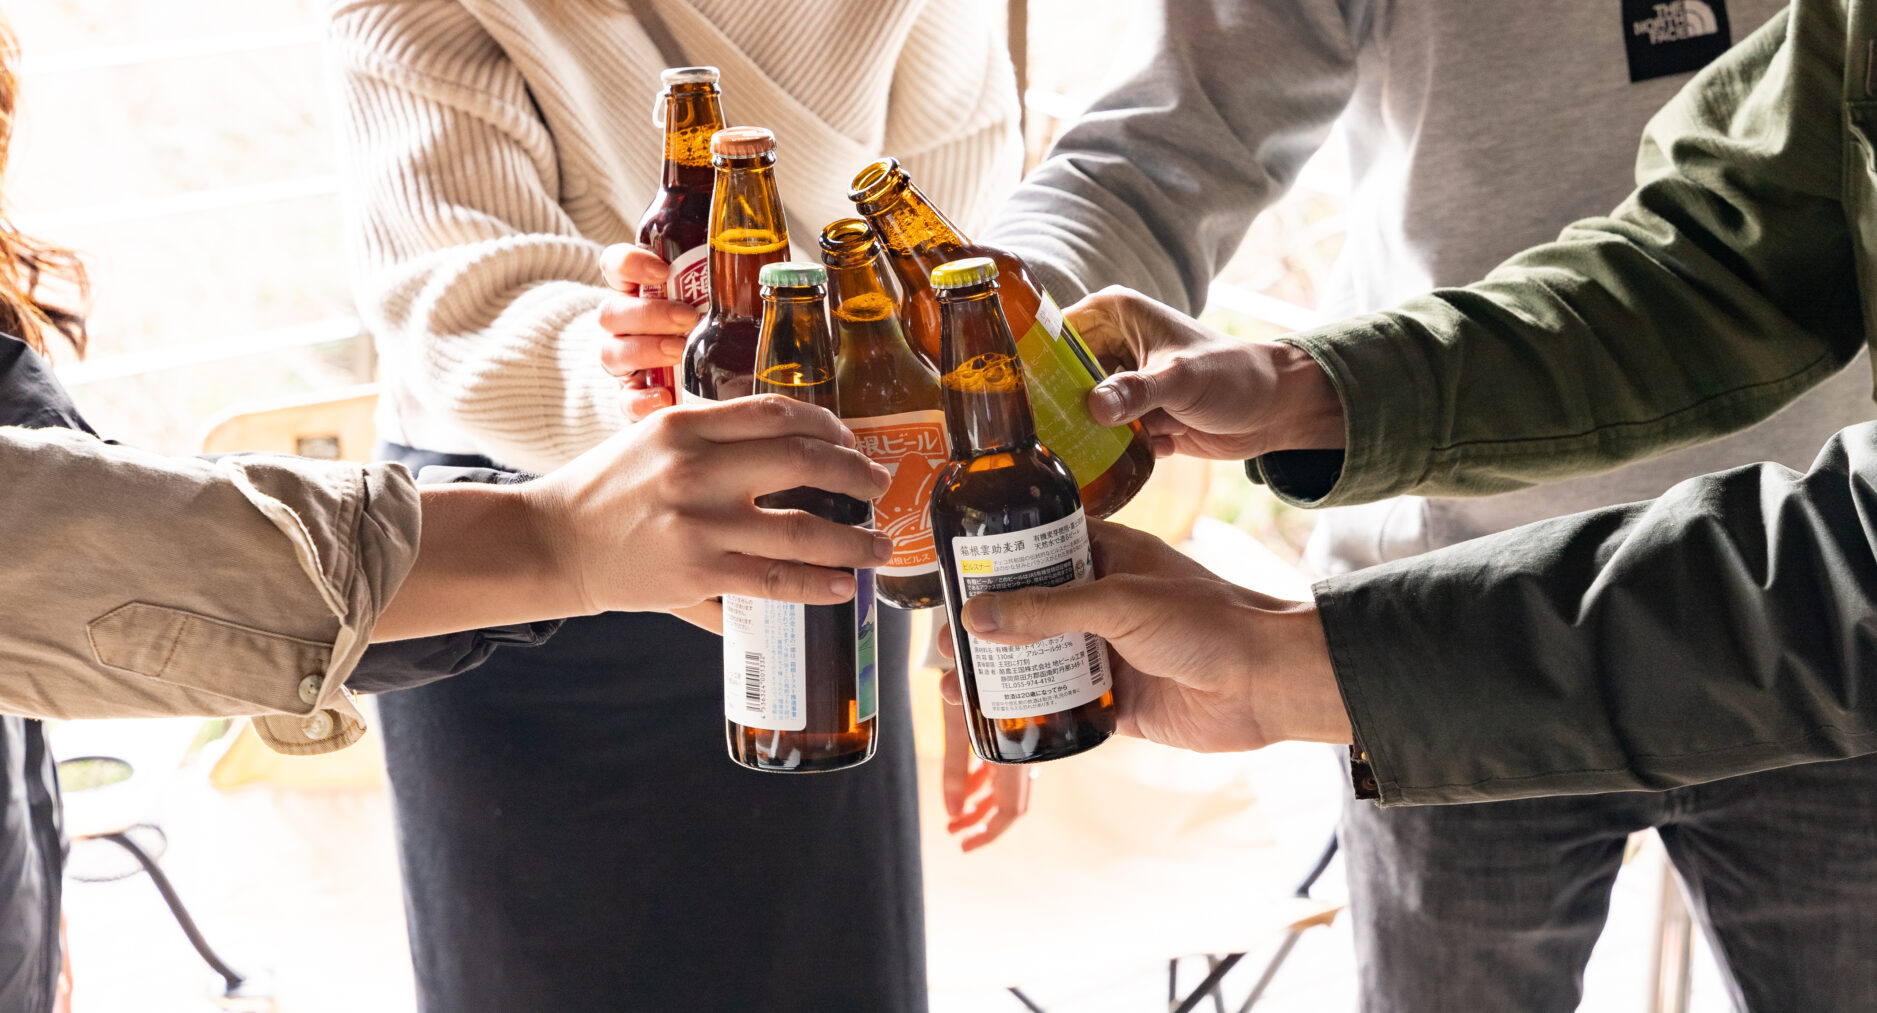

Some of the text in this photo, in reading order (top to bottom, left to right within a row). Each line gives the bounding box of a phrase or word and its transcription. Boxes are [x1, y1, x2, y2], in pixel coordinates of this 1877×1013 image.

[856, 431, 939, 455] 根ビール
[960, 540, 1025, 556] 箱根雲助麦酒
